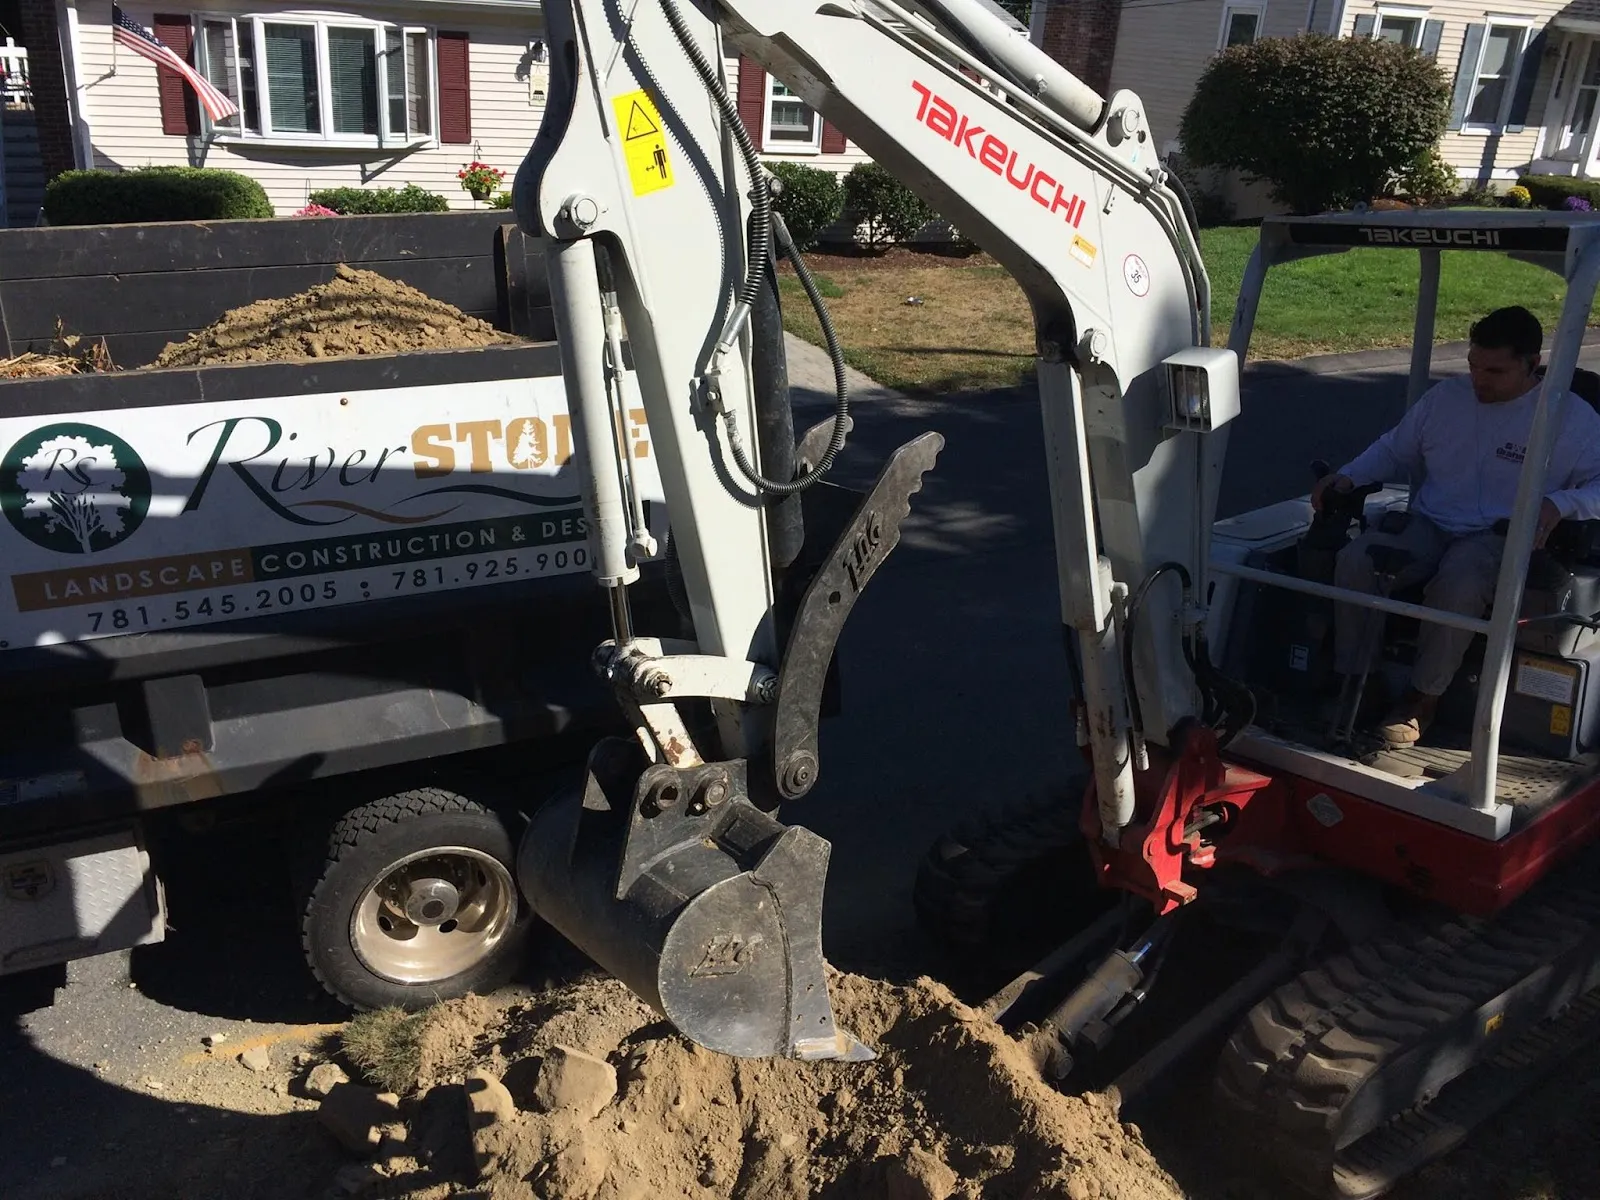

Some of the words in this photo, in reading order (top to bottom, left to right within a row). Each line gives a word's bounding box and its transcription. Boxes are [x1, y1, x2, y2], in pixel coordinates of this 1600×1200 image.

[1130, 270, 1142, 285] 35
[180, 416, 408, 526] River
[411, 409, 649, 479] STOE
[44, 558, 245, 601] LANDSCAPE
[259, 526, 497, 575] CONSTRUCTION
[511, 524, 526, 542] &
[542, 517, 588, 539] DES
[87, 582, 338, 632] 781.545.2005
[392, 548, 587, 591] 781.925.900
